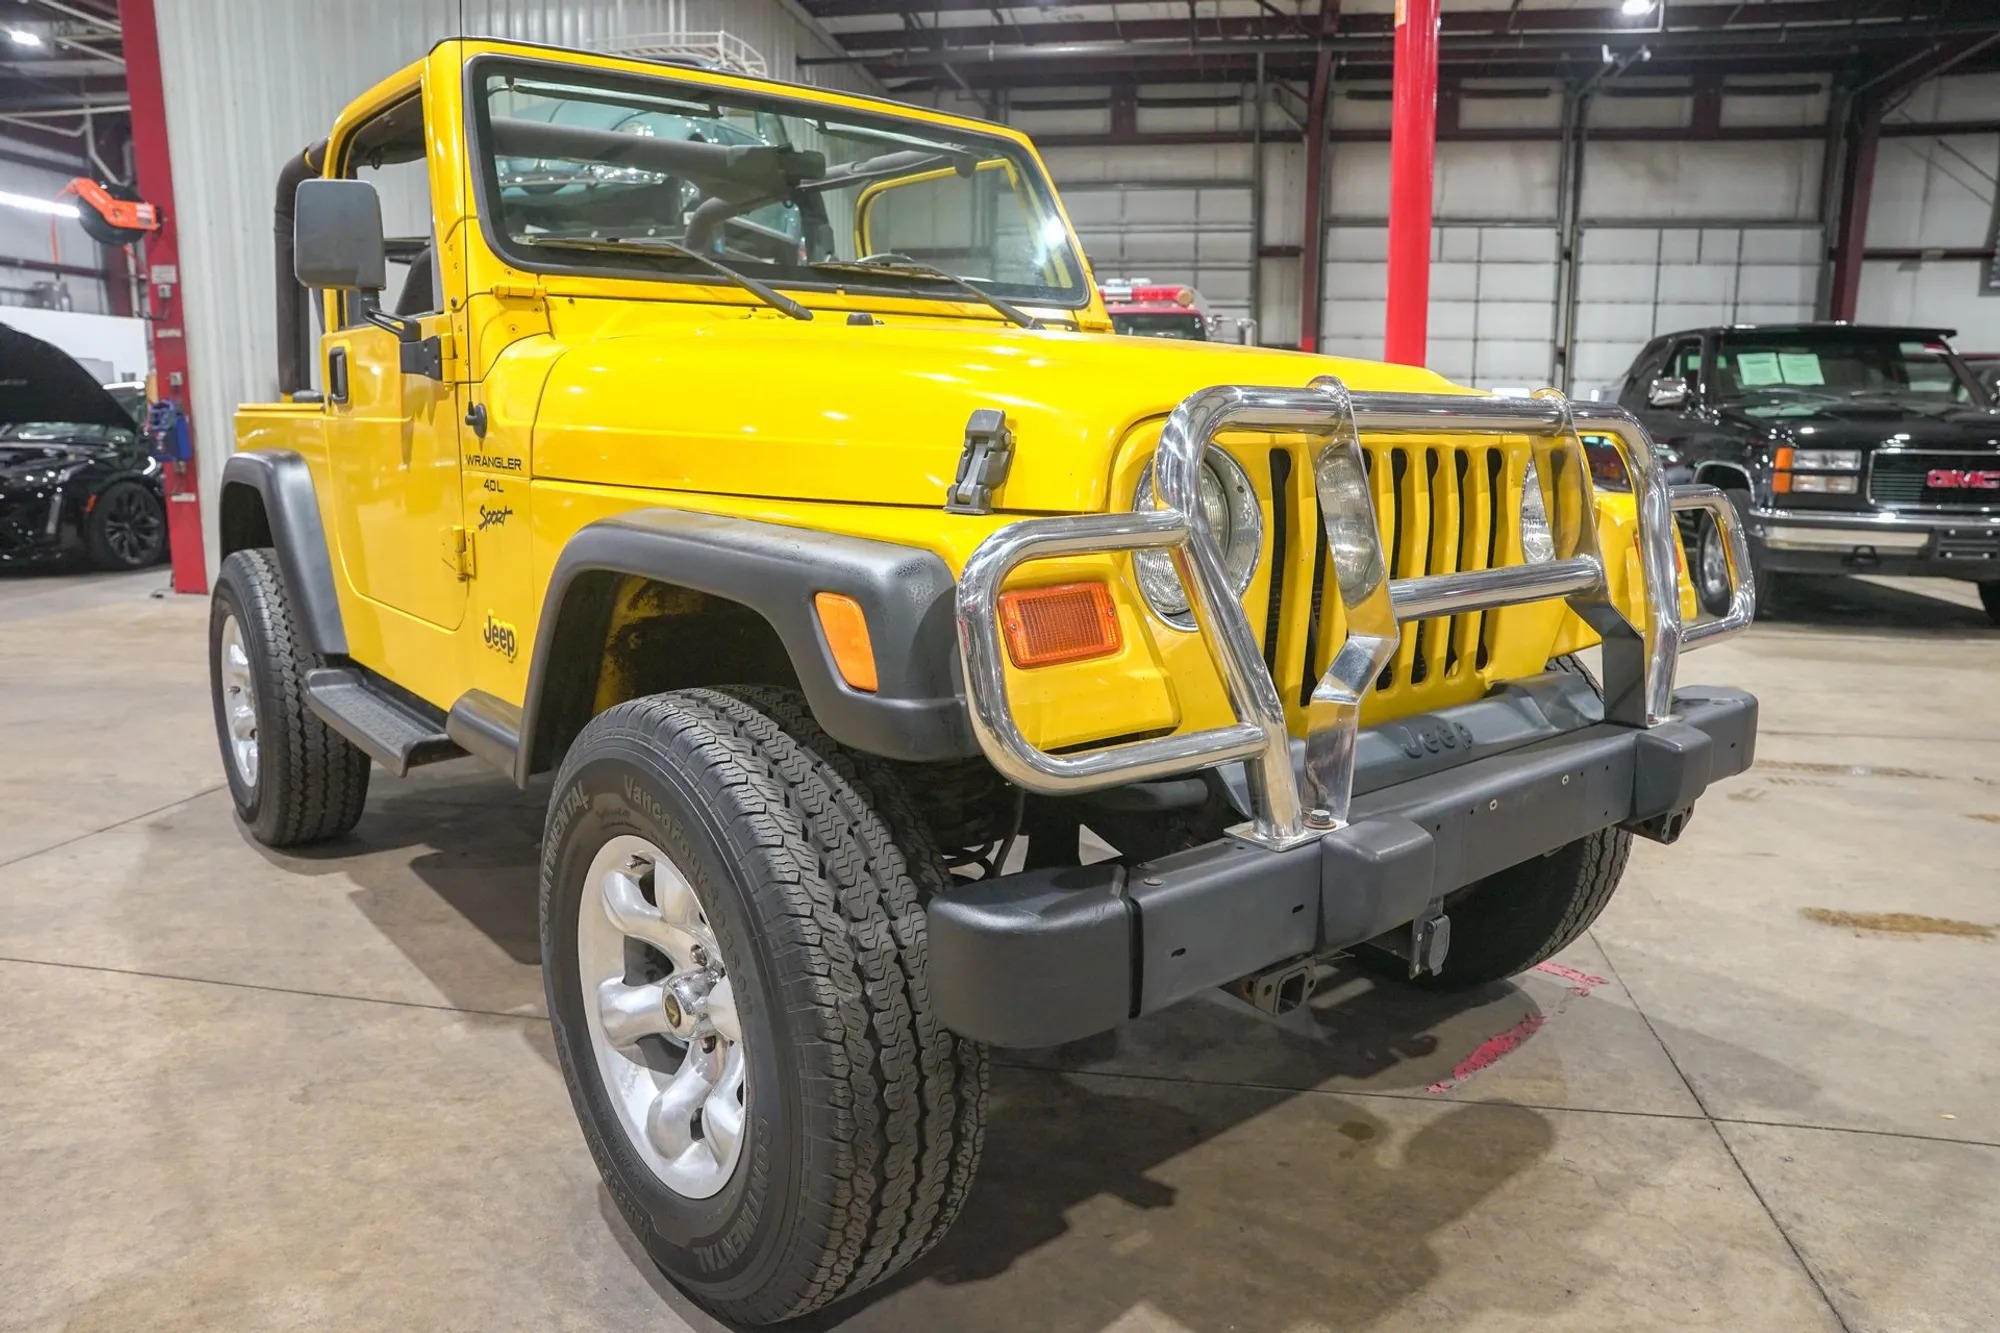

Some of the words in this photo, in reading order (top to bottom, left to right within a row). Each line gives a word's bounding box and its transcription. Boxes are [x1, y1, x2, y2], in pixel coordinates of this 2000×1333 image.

[465, 454, 522, 471] WRANGLER
[1927, 469, 2000, 489] GMC
[478, 504, 513, 533] Sport
[483, 612, 517, 660] Jeep
[1398, 719, 1474, 760] Jeep
[691, 1115, 774, 1274] CONTINENTAL
